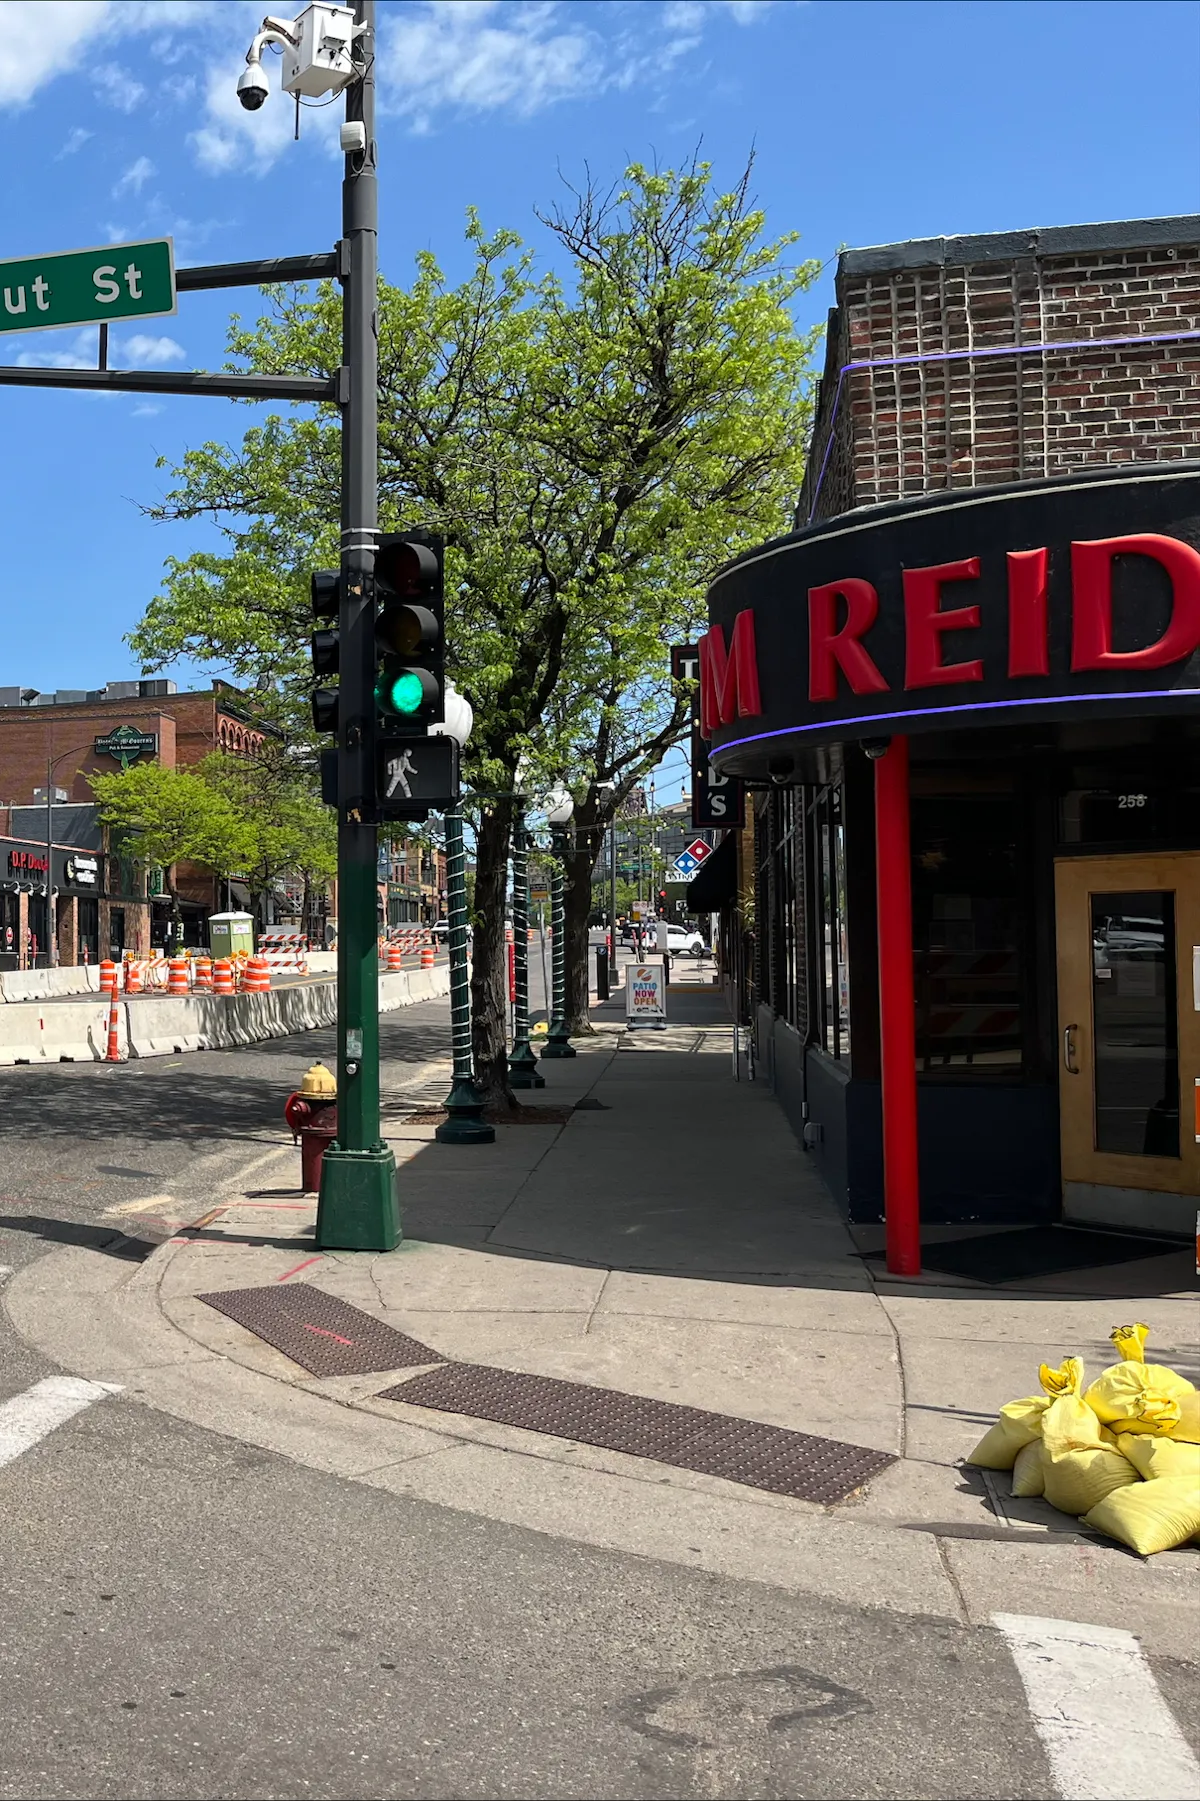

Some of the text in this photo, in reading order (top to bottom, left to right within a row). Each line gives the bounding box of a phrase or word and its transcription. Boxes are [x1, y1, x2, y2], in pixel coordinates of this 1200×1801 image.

[91, 262, 143, 304] St
[807, 532, 1200, 703] REID
[1118, 794, 1146, 809] 258
[632, 982, 658, 990] PATIO
